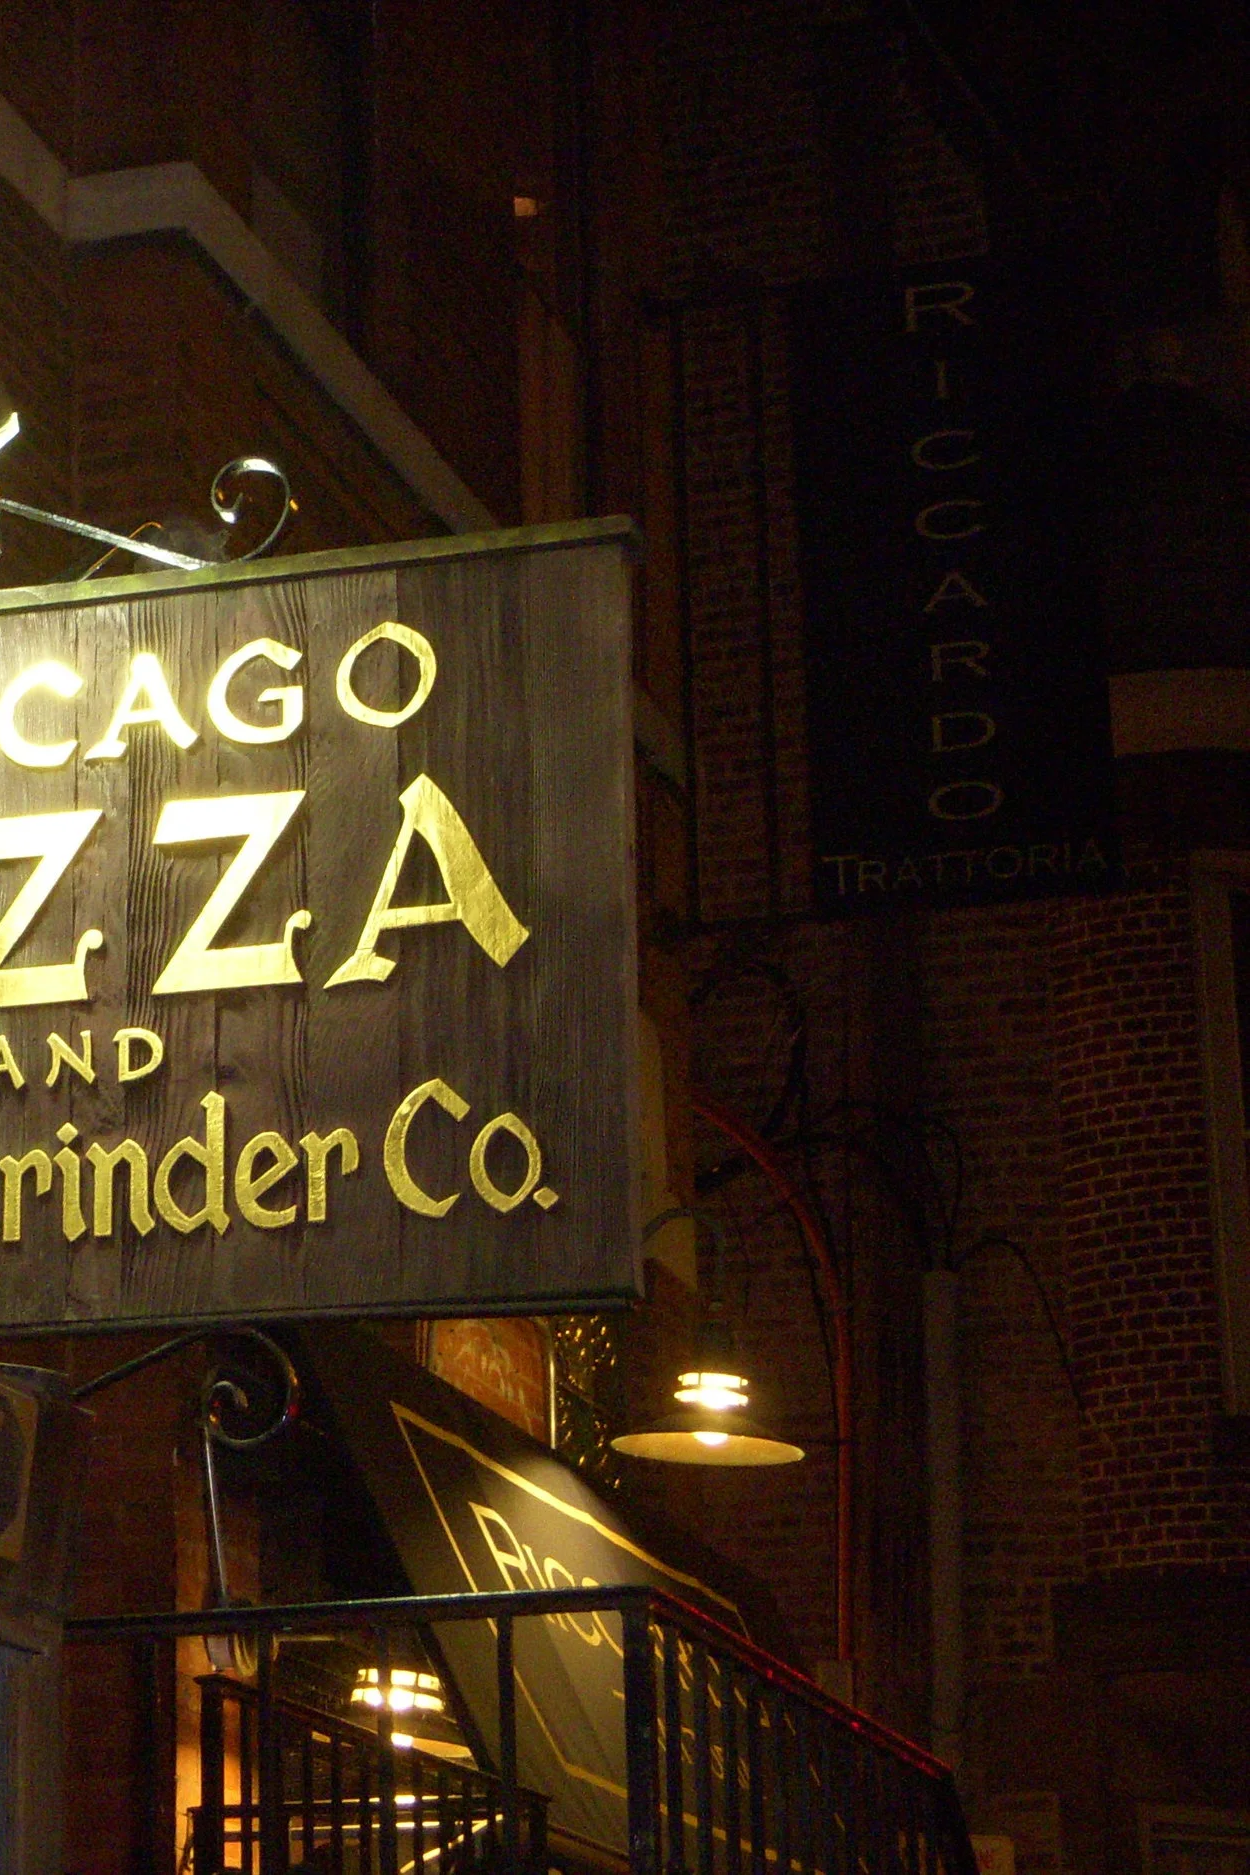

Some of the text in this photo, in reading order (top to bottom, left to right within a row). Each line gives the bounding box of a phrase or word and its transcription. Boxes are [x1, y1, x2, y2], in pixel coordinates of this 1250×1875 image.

[903, 280, 1005, 820] RICCARDO
[820, 837, 1109, 896] TRATTORIA
[383, 1078, 560, 1220] Co.
